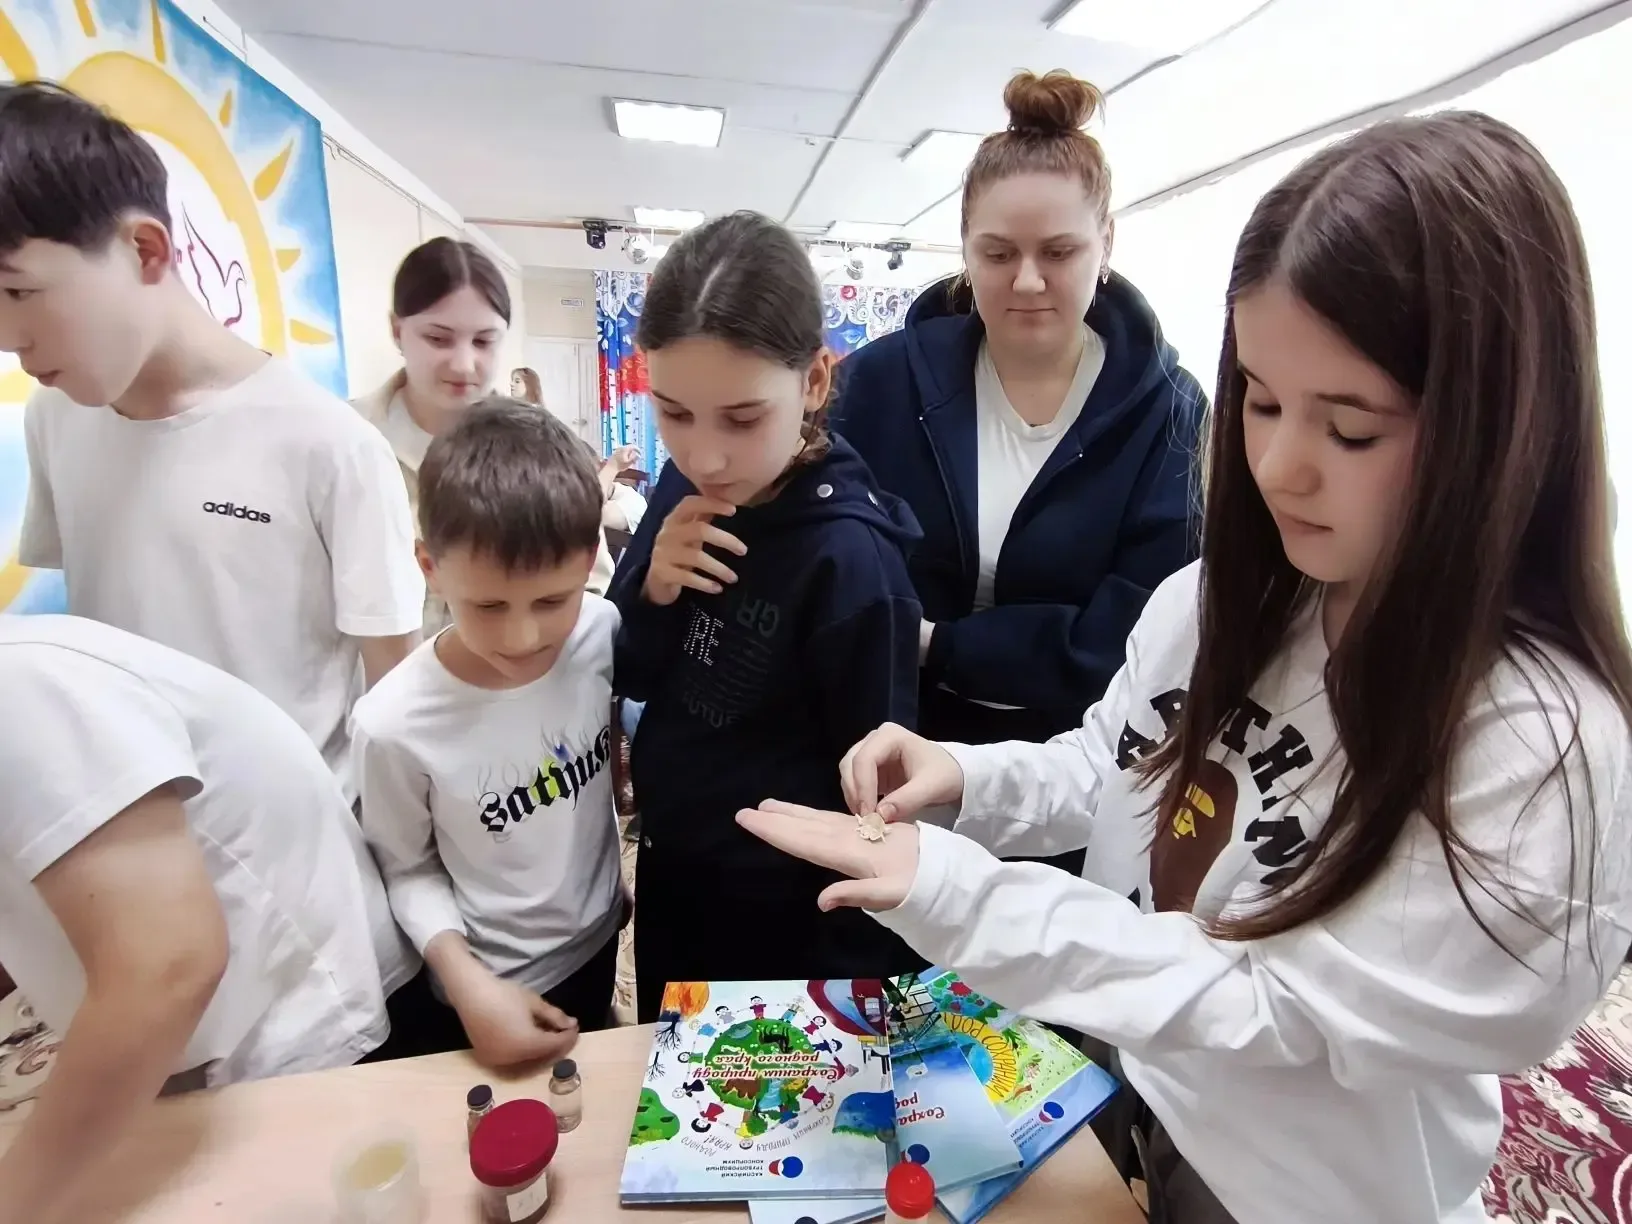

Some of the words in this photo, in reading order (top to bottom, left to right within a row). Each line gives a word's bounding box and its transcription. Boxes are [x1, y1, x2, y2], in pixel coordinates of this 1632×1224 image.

[202, 501, 271, 523] adidas
[715, 1052, 752, 1066] края
[758, 1051, 820, 1063] родного
[692, 1066, 757, 1078] природу
[764, 1066, 837, 1080] Сохраним
[896, 1107, 945, 1126] Сохра
